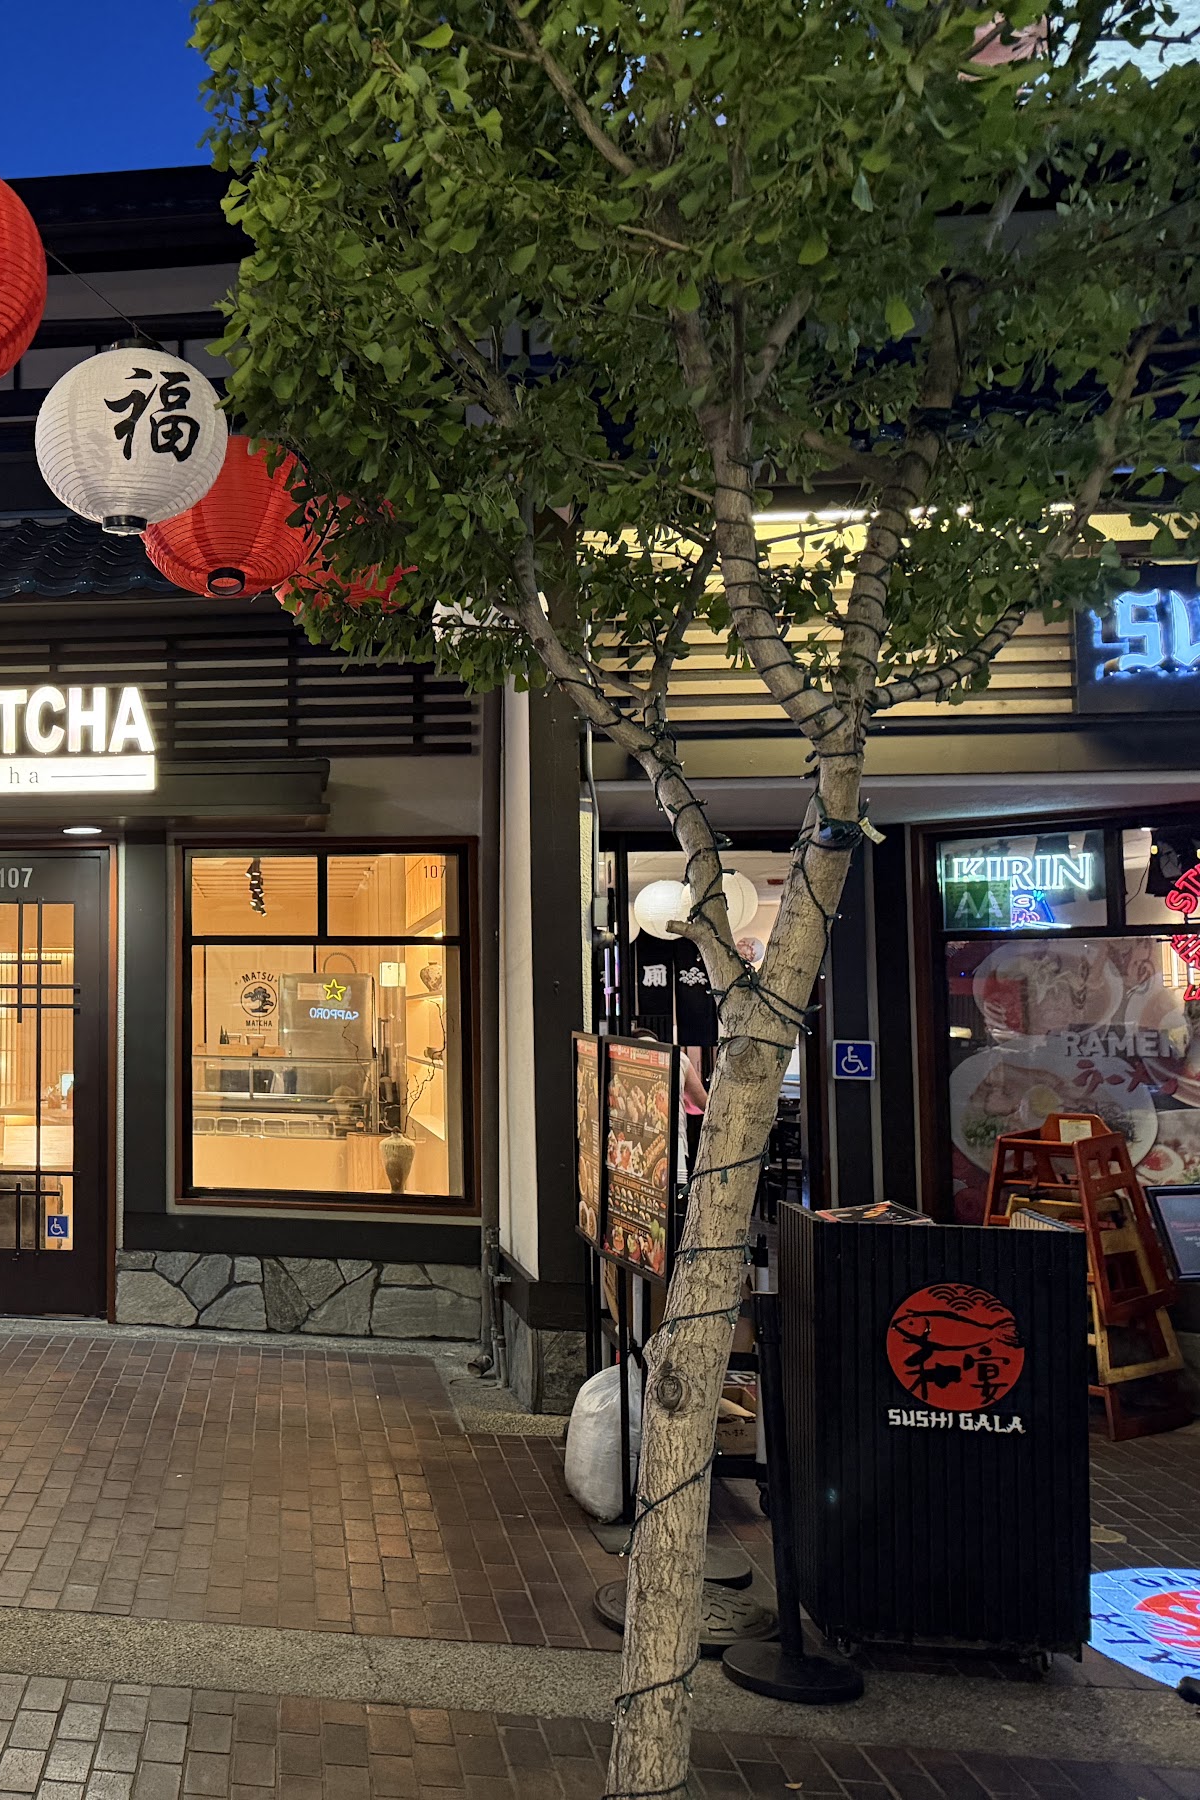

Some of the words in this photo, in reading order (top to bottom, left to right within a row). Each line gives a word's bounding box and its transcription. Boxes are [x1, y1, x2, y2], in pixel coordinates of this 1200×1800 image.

[104, 367, 200, 462] 福
[423, 864, 447, 879] 107
[952, 852, 1092, 891] KIRIN
[241, 972, 275, 984] MATSU
[245, 1019, 273, 1028] MATCHA
[888, 1409, 954, 1429] SUSHI
[959, 1412, 1026, 1434] GALA
